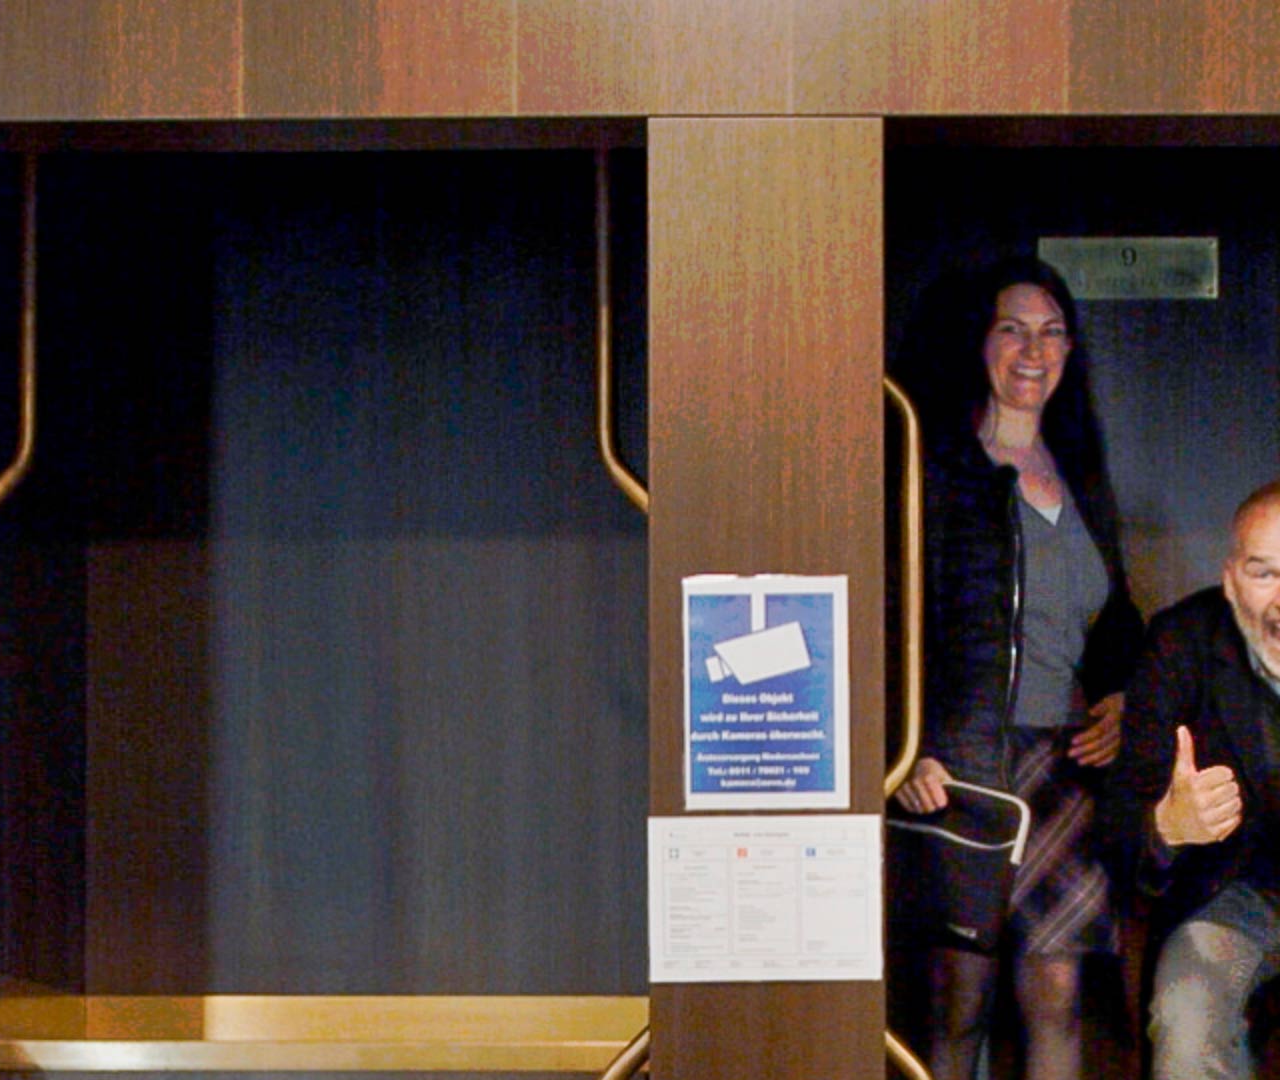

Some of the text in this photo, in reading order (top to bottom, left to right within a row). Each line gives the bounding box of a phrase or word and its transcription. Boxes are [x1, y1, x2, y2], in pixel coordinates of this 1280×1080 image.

[722, 692, 795, 706] Dieses Objekt
[700, 712, 723, 723] wird
[740, 711, 765, 723] Ihrer
[766, 710, 819, 722] Sicherheit
[691, 730, 719, 742] durch
[721, 729, 767, 741] Kameras
